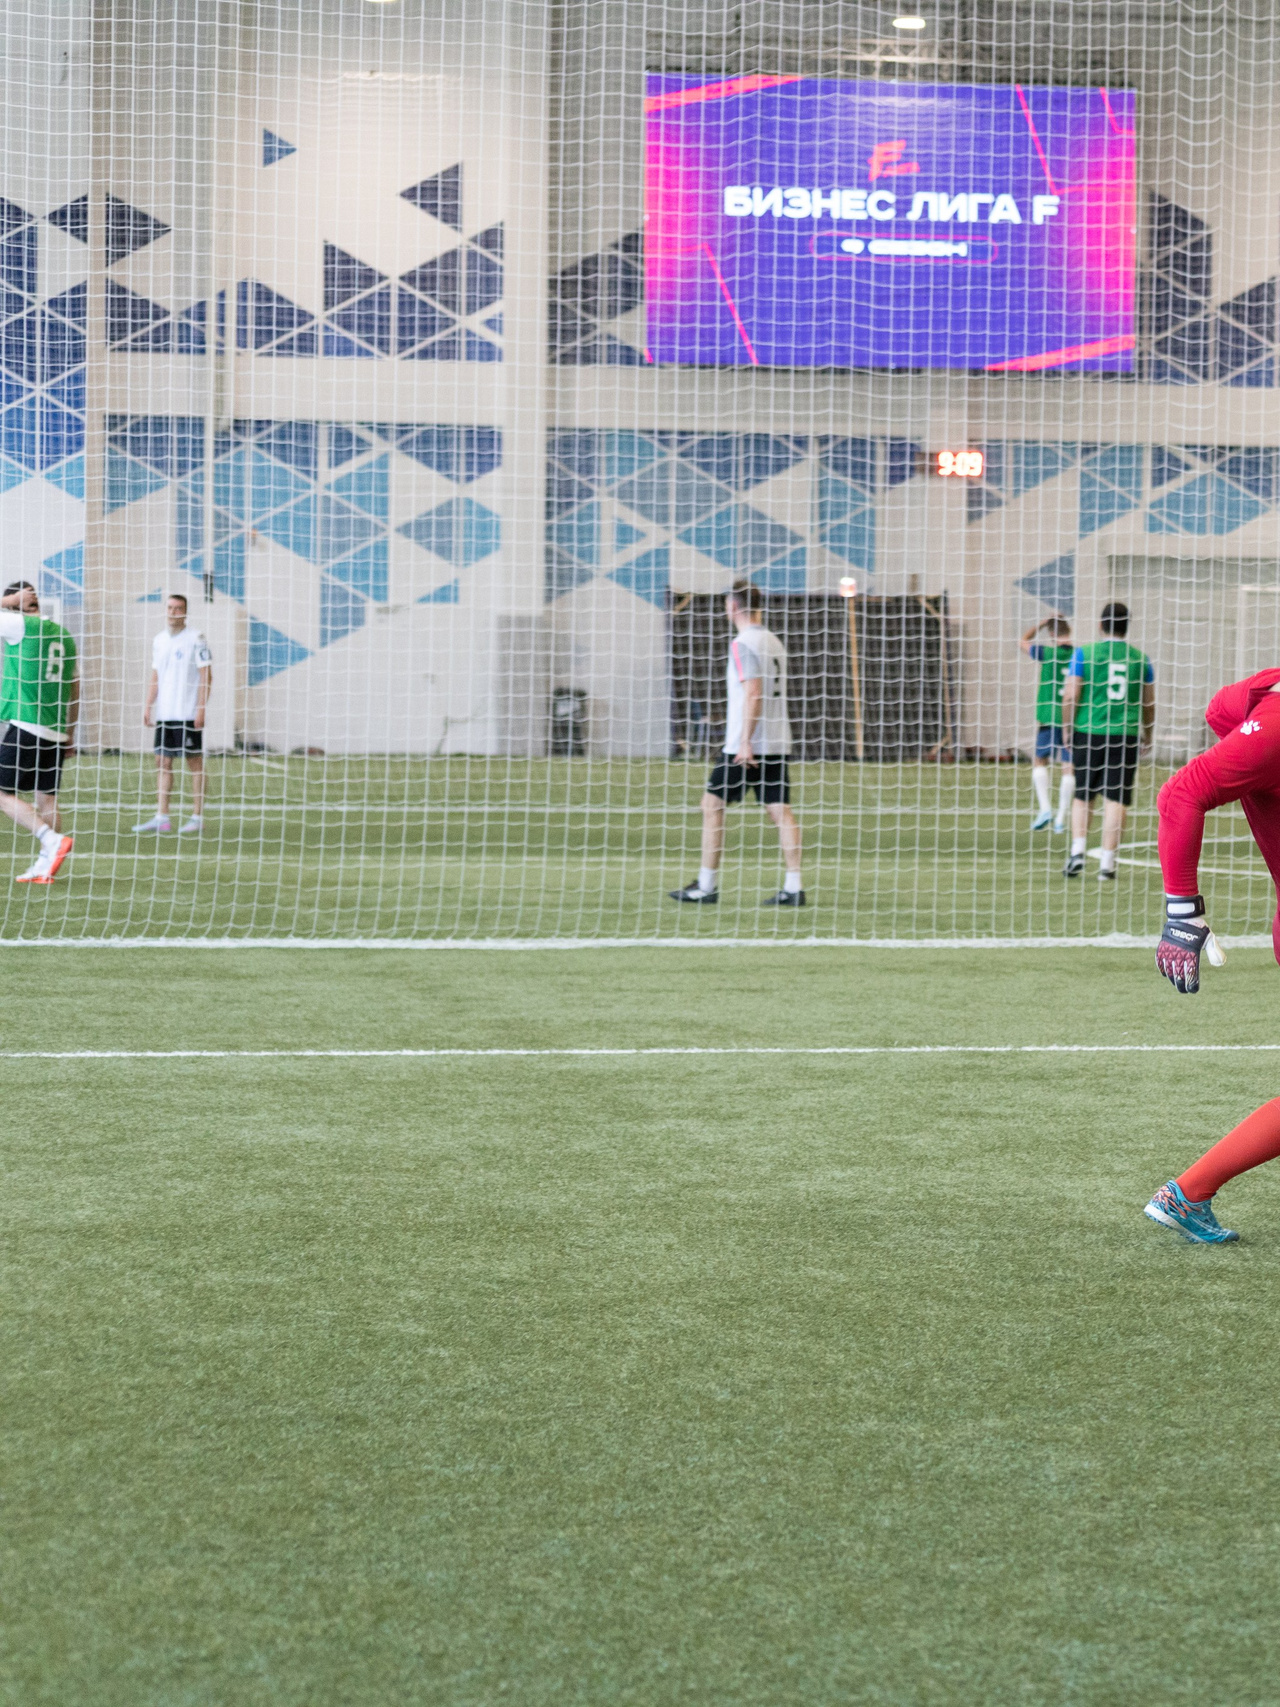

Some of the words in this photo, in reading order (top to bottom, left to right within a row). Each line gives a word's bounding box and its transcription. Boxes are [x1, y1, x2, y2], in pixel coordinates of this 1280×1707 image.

[723, 185, 897, 221] БИЗНЕС
[906, 191, 1022, 225] ЛИГА
[1032, 194, 1061, 225] F
[1106, 662, 1128, 701] 5
